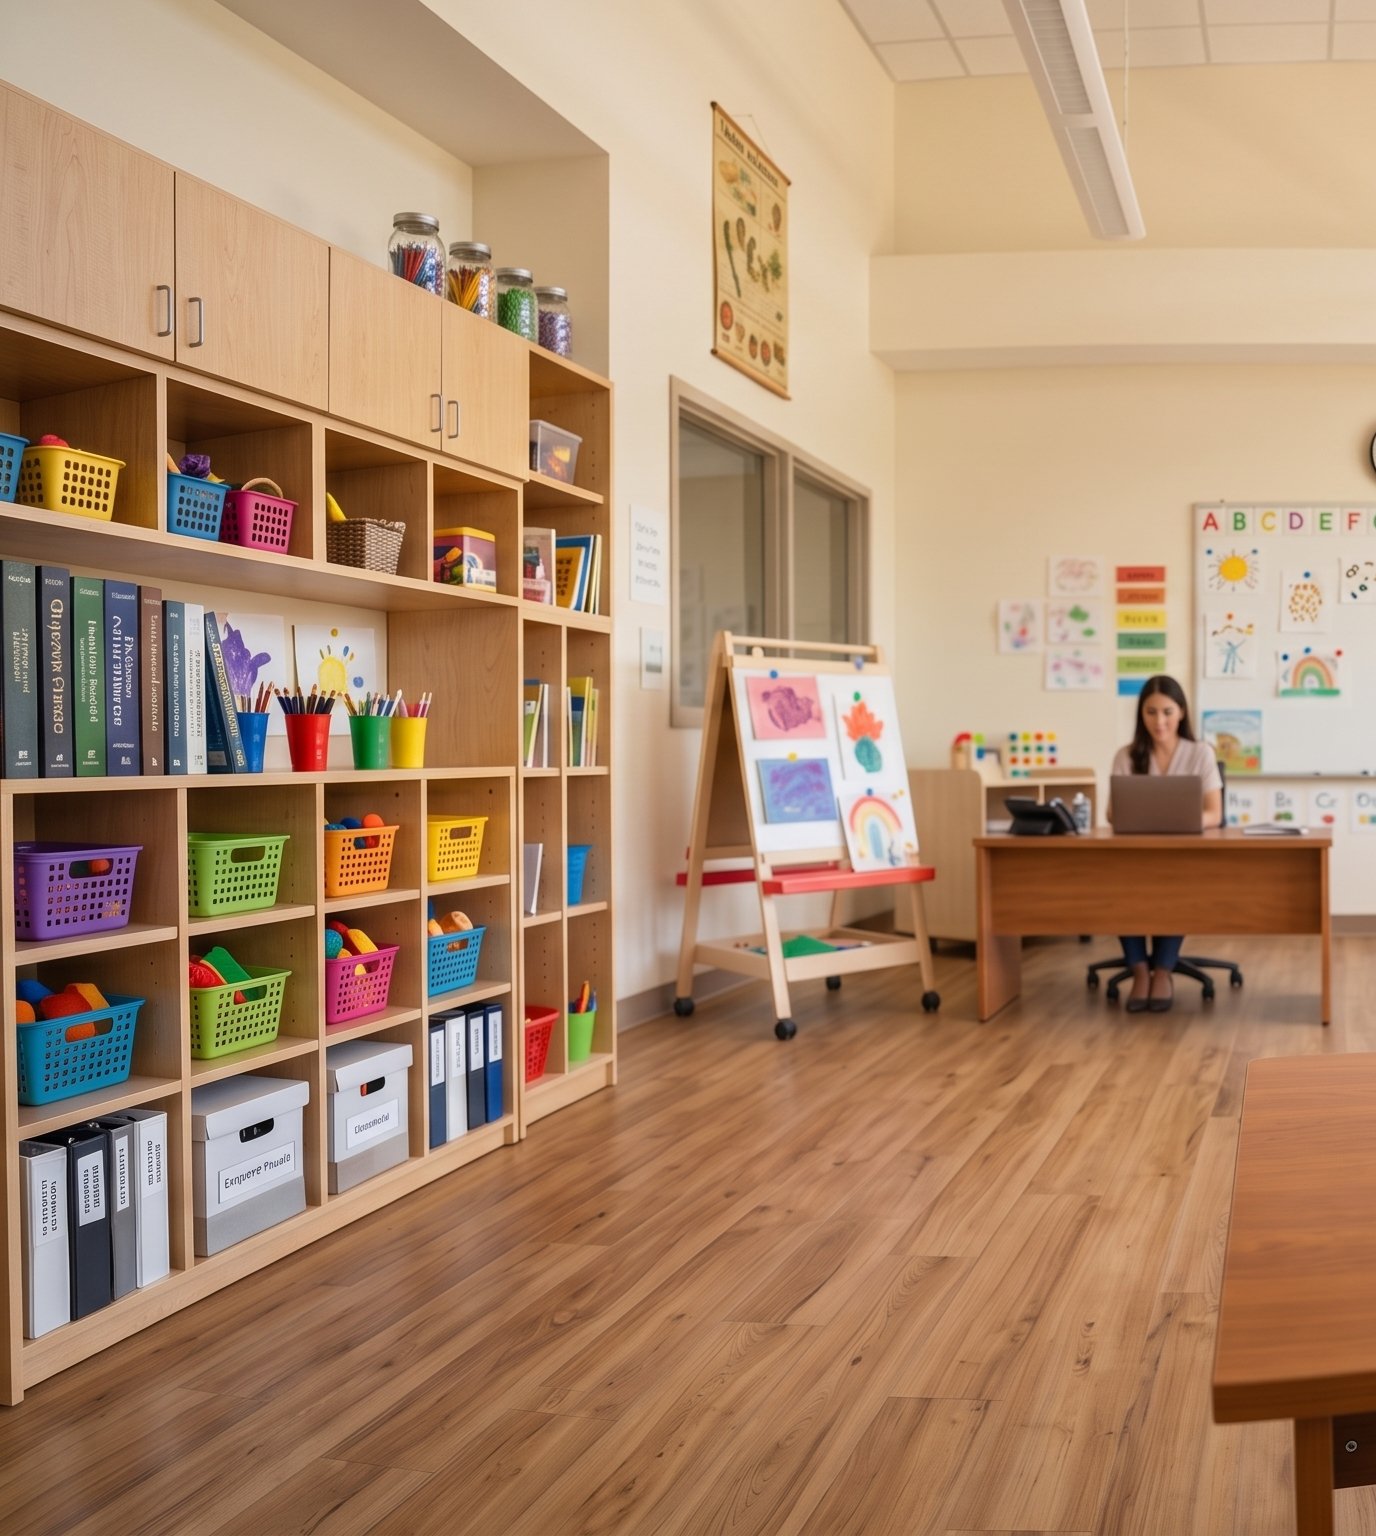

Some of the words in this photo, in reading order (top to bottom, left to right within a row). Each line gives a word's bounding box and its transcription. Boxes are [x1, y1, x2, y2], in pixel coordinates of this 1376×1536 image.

[1203, 513, 1219, 531] A
[1233, 512, 1247, 531] B
[1260, 513, 1277, 531] C
[1289, 513, 1304, 530] D
[1320, 513, 1332, 531] E
[1347, 513, 1361, 531] F
